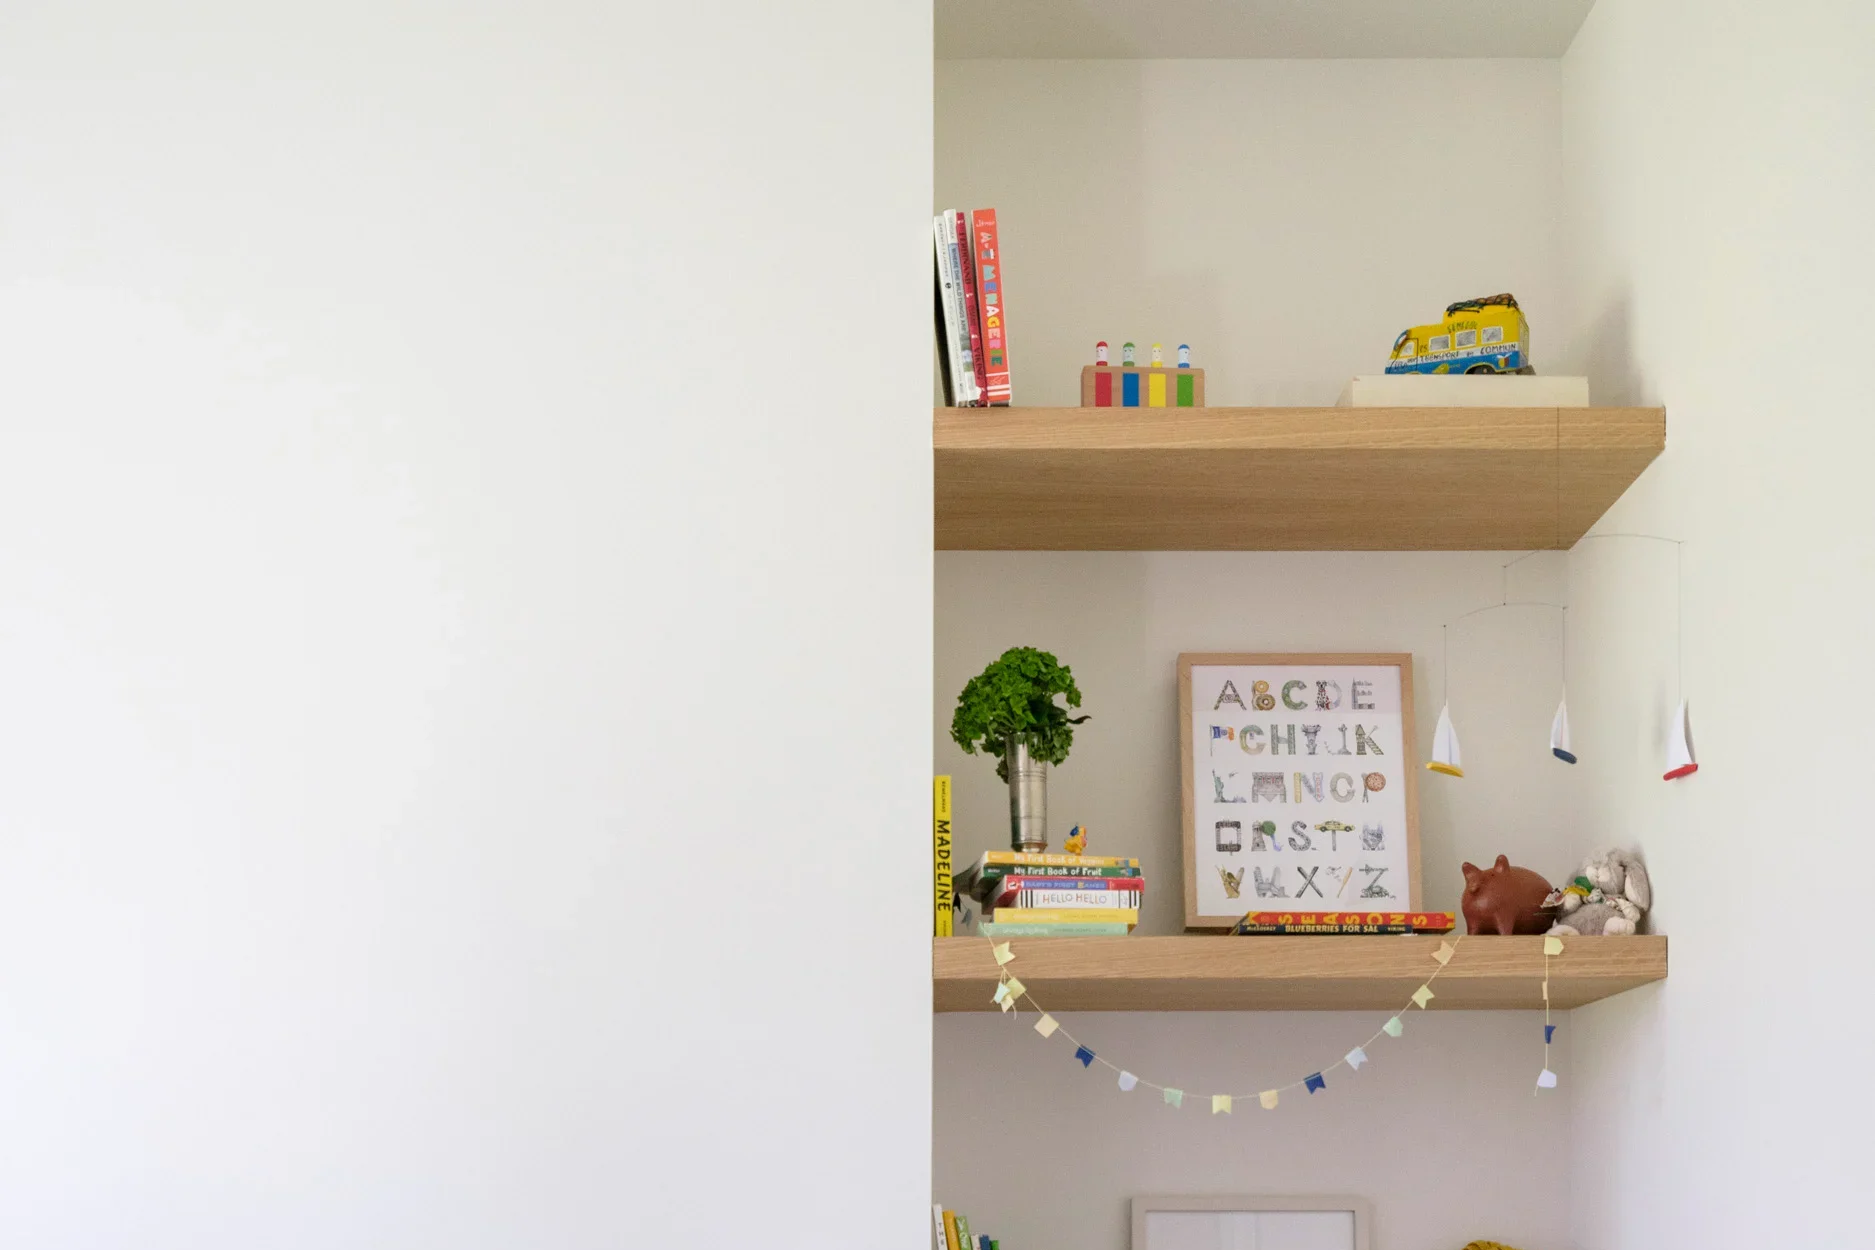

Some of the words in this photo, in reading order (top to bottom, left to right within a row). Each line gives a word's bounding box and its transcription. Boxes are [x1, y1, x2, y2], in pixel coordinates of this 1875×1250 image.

[951, 247, 959, 267] WHERE
[959, 232, 971, 284] FERDINAND
[982, 263, 1003, 366] MENAGERIE
[937, 820, 950, 911] MADELINE
[1027, 854, 1045, 863] First
[1046, 855, 1065, 863] Book
[1014, 867, 1025, 877] My
[1028, 867, 1044, 875] First
[1047, 867, 1067, 875] Book
[1071, 867, 1079, 876] of
[1083, 867, 1102, 876] Fruit
[1043, 894, 1072, 903] HELLO
[1076, 894, 1107, 904] HELLO
[1285, 925, 1340, 933] BLUEBERRIES
[1342, 925, 1360, 933] FOR
[1364, 925, 1378, 933] SAL
[937, 1221, 945, 1245] THE
[959, 1231, 970, 1248] One
